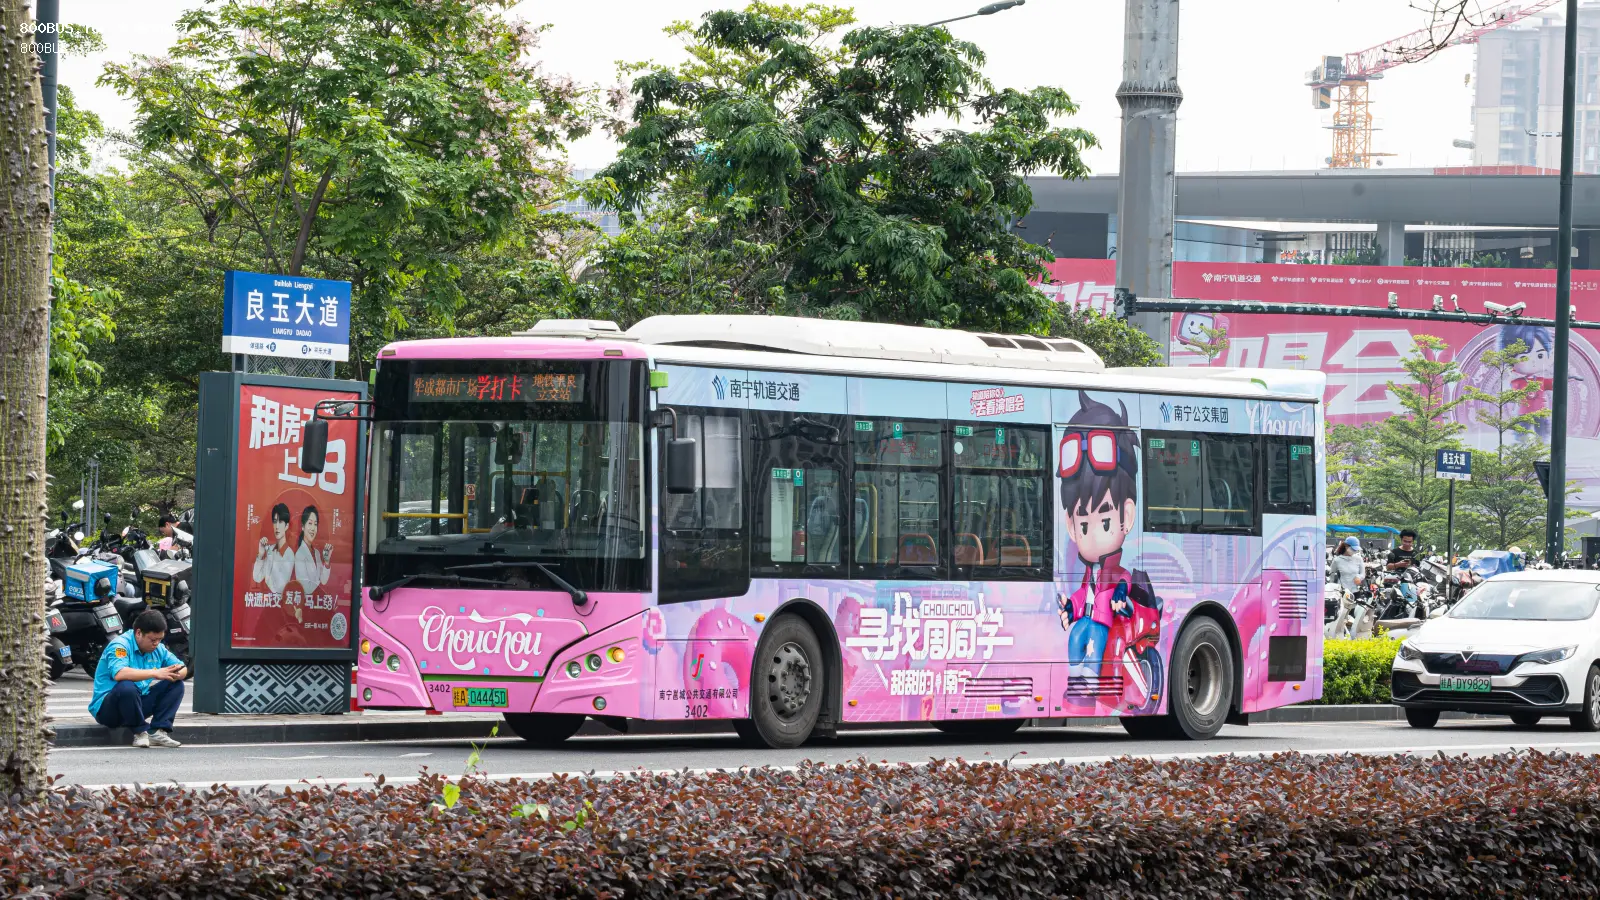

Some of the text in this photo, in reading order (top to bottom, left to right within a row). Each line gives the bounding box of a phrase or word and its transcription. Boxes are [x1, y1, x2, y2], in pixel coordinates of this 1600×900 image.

[1213, 274, 1261, 283] 南宁轨道交通
[246, 289, 339, 327] 良玉大道
[272, 327, 312, 337] LIANGYU DADAO
[476, 374, 523, 401] 学打卡
[535, 388, 571, 401] 立交站
[730, 378, 800, 402] 南宁轨道交通
[974, 395, 1024, 417] 去看演唱会
[1174, 404, 1229, 424] 南宁公交集团
[1442, 452, 1466, 466] 良玉大道
[244, 591, 282, 608] 快速成交
[923, 603, 973, 616] CHOUCHOU
[846, 592, 1013, 660] 寻找周同学
[418, 605, 543, 671] Chouchou
[429, 683, 451, 693] 3402
[890, 669, 973, 696] 甜甜的 南宁
[1441, 677, 1489, 690] 桂A DY9829
[453, 690, 506, 705] 桂A 04445D
[659, 688, 738, 701] 南宁邕城公共交通有限公司
[685, 704, 708, 718] 3402
